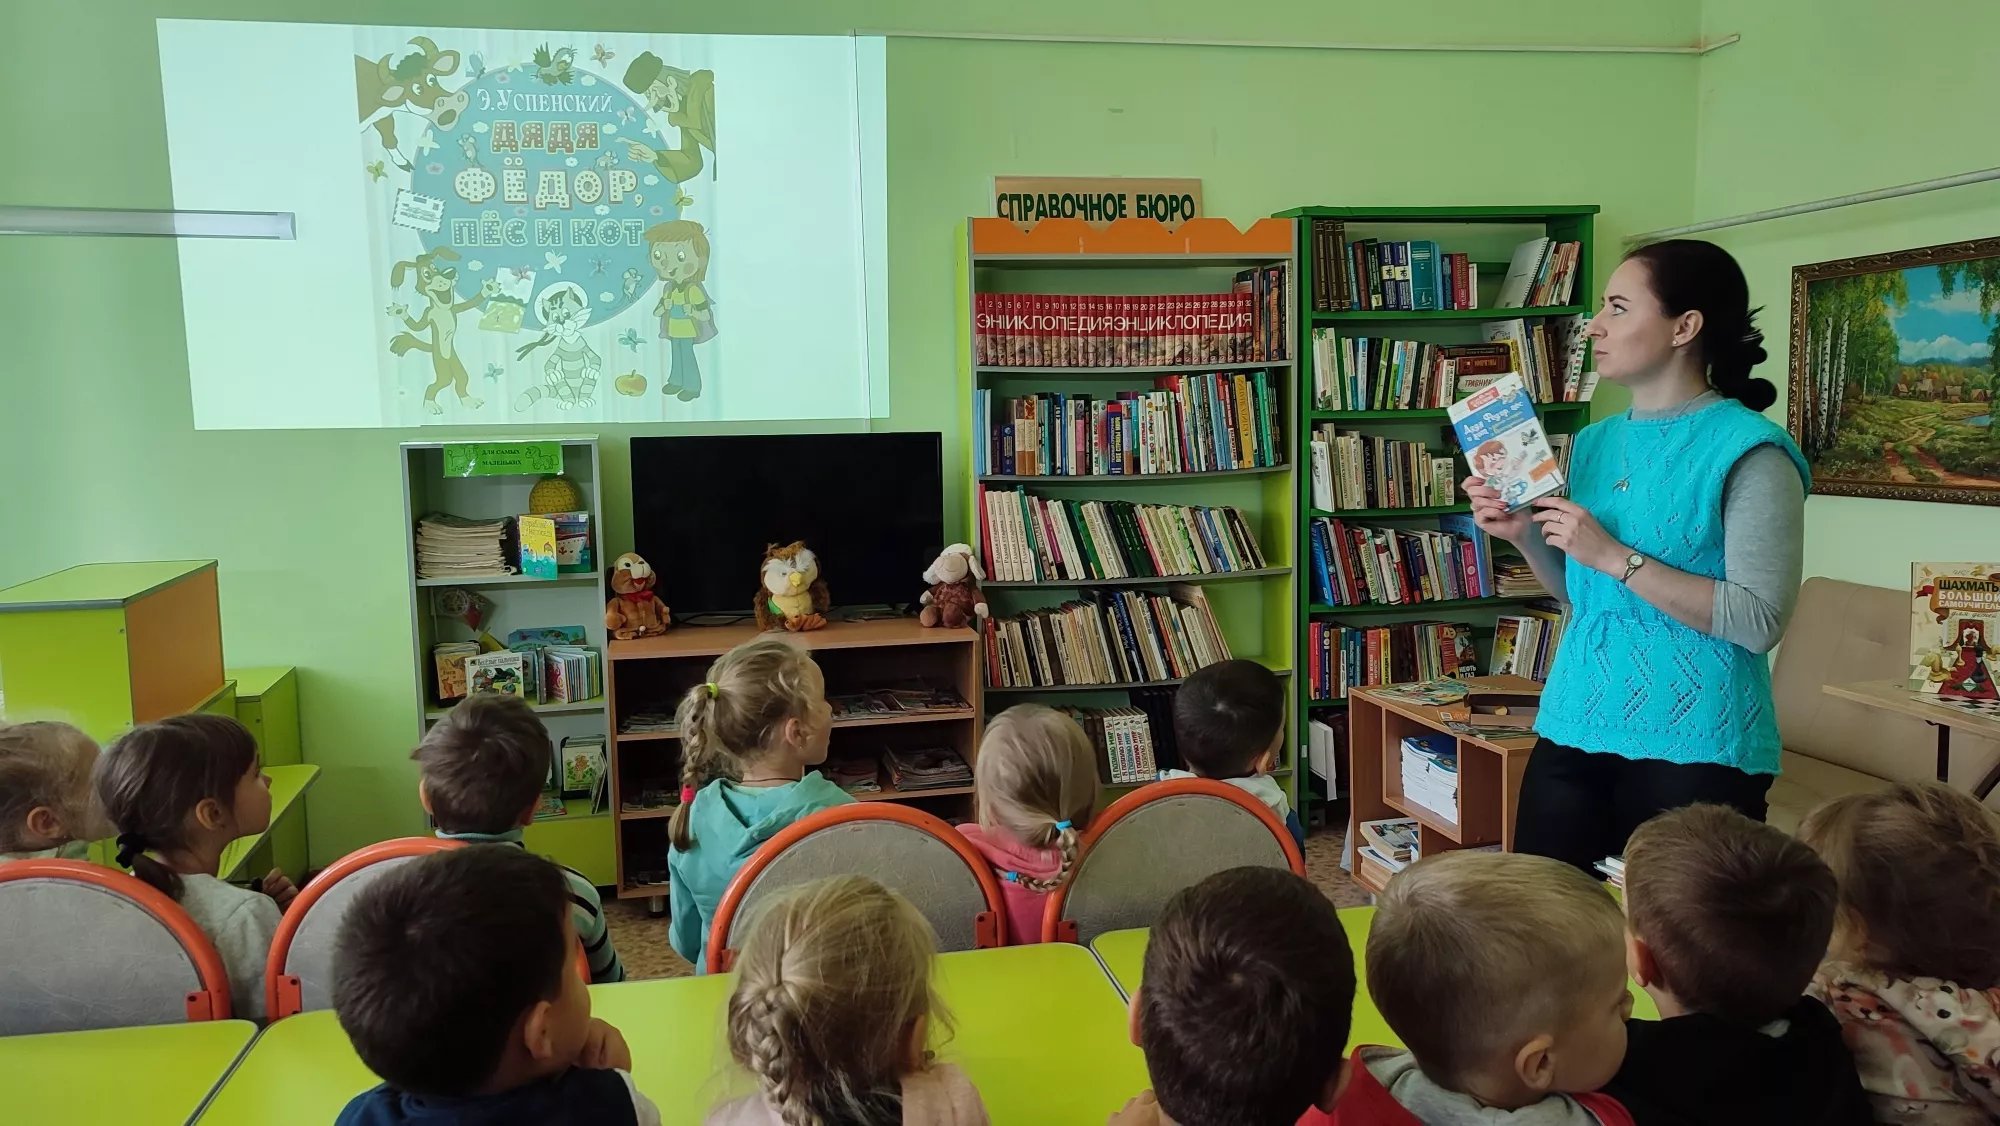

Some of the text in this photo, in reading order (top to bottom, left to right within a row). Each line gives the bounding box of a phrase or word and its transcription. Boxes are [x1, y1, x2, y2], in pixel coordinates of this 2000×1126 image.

[490, 120, 599, 154] ДЯДЯ
[454, 157, 644, 211] ФЁДОР,
[997, 193, 1195, 222] СПРАВОЧНОЕ БЮРО
[451, 210, 528, 247] ПЁС
[535, 219, 562, 246] И
[571, 218, 644, 246] КОТ
[1114, 313, 1252, 333] ЭНЦИКЛОПЕДИЯ
[1465, 379, 1493, 387] ТРАВНИК
[1111, 746, 1119, 772] ПОЗНАЮ
[1133, 744, 1142, 769] ПОЗНАЮ
